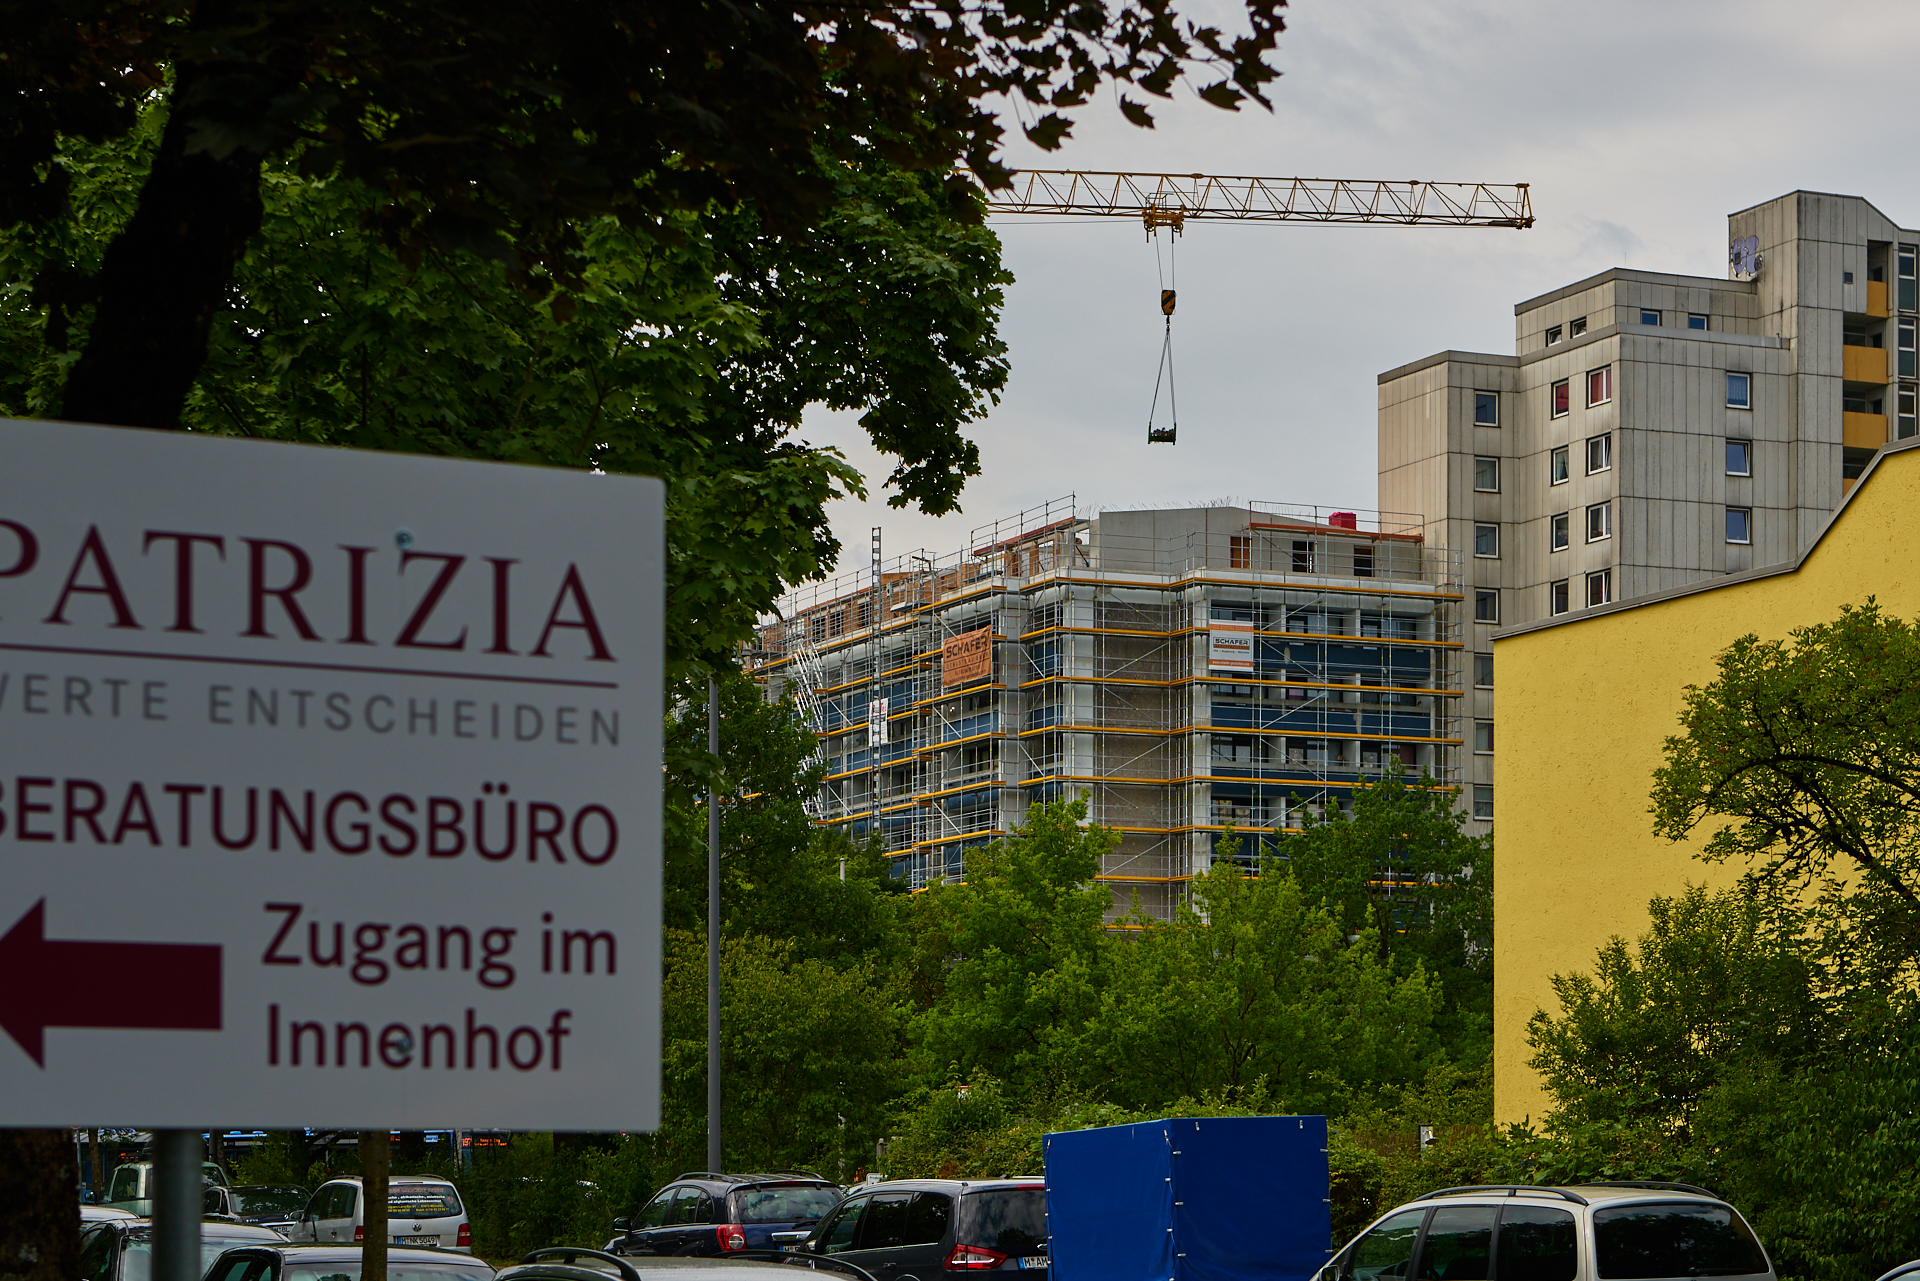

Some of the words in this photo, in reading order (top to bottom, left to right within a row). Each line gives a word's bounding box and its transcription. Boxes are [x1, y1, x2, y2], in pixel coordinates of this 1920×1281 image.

[0, 672, 168, 721] ERTE
[209, 685, 618, 746] ENTSCHEIDEN
[0, 775, 619, 866] ERATUNGSBÜRO
[261, 902, 517, 990] Zugang
[541, 911, 616, 975] im
[267, 1003, 572, 1072] Innenhof
